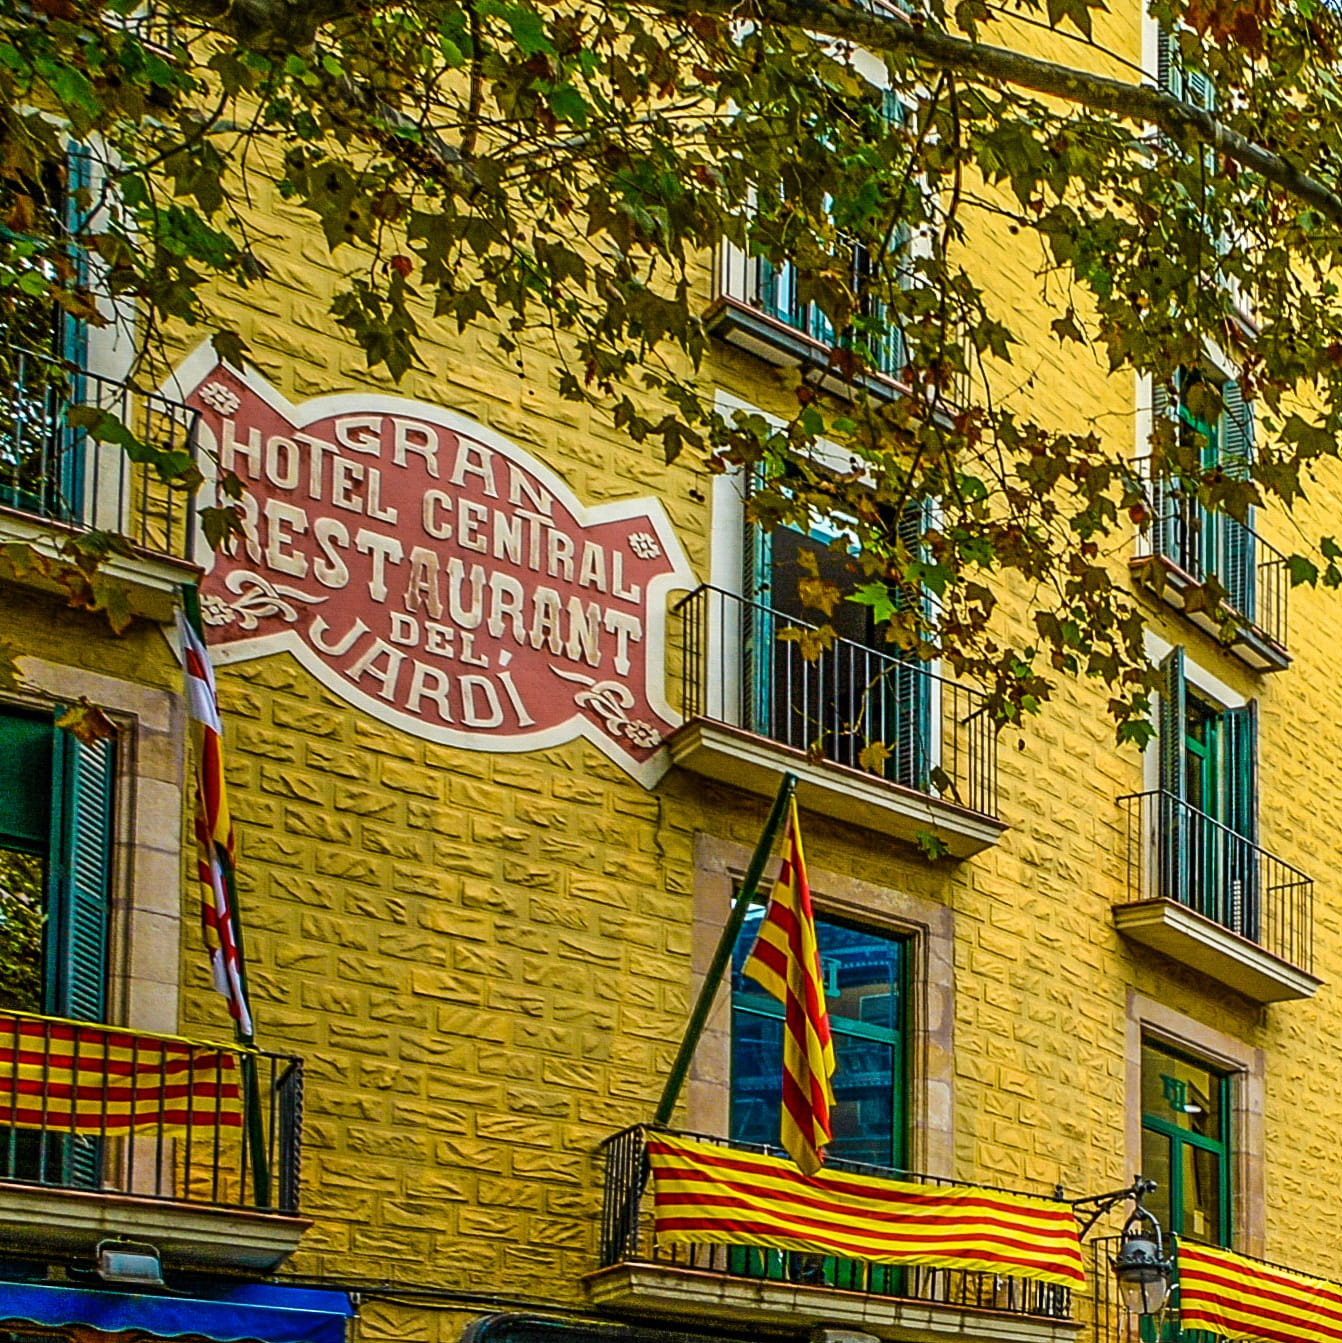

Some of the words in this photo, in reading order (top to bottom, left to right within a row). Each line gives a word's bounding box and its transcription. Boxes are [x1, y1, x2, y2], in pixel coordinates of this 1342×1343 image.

[221, 418, 398, 525] HOTEL
[422, 489, 641, 604] CENTRAL
[335, 416, 554, 517] GRAN
[218, 490, 642, 677] RESTAURANT
[389, 611, 488, 669] DEL
[308, 615, 535, 728] JARDÍ
